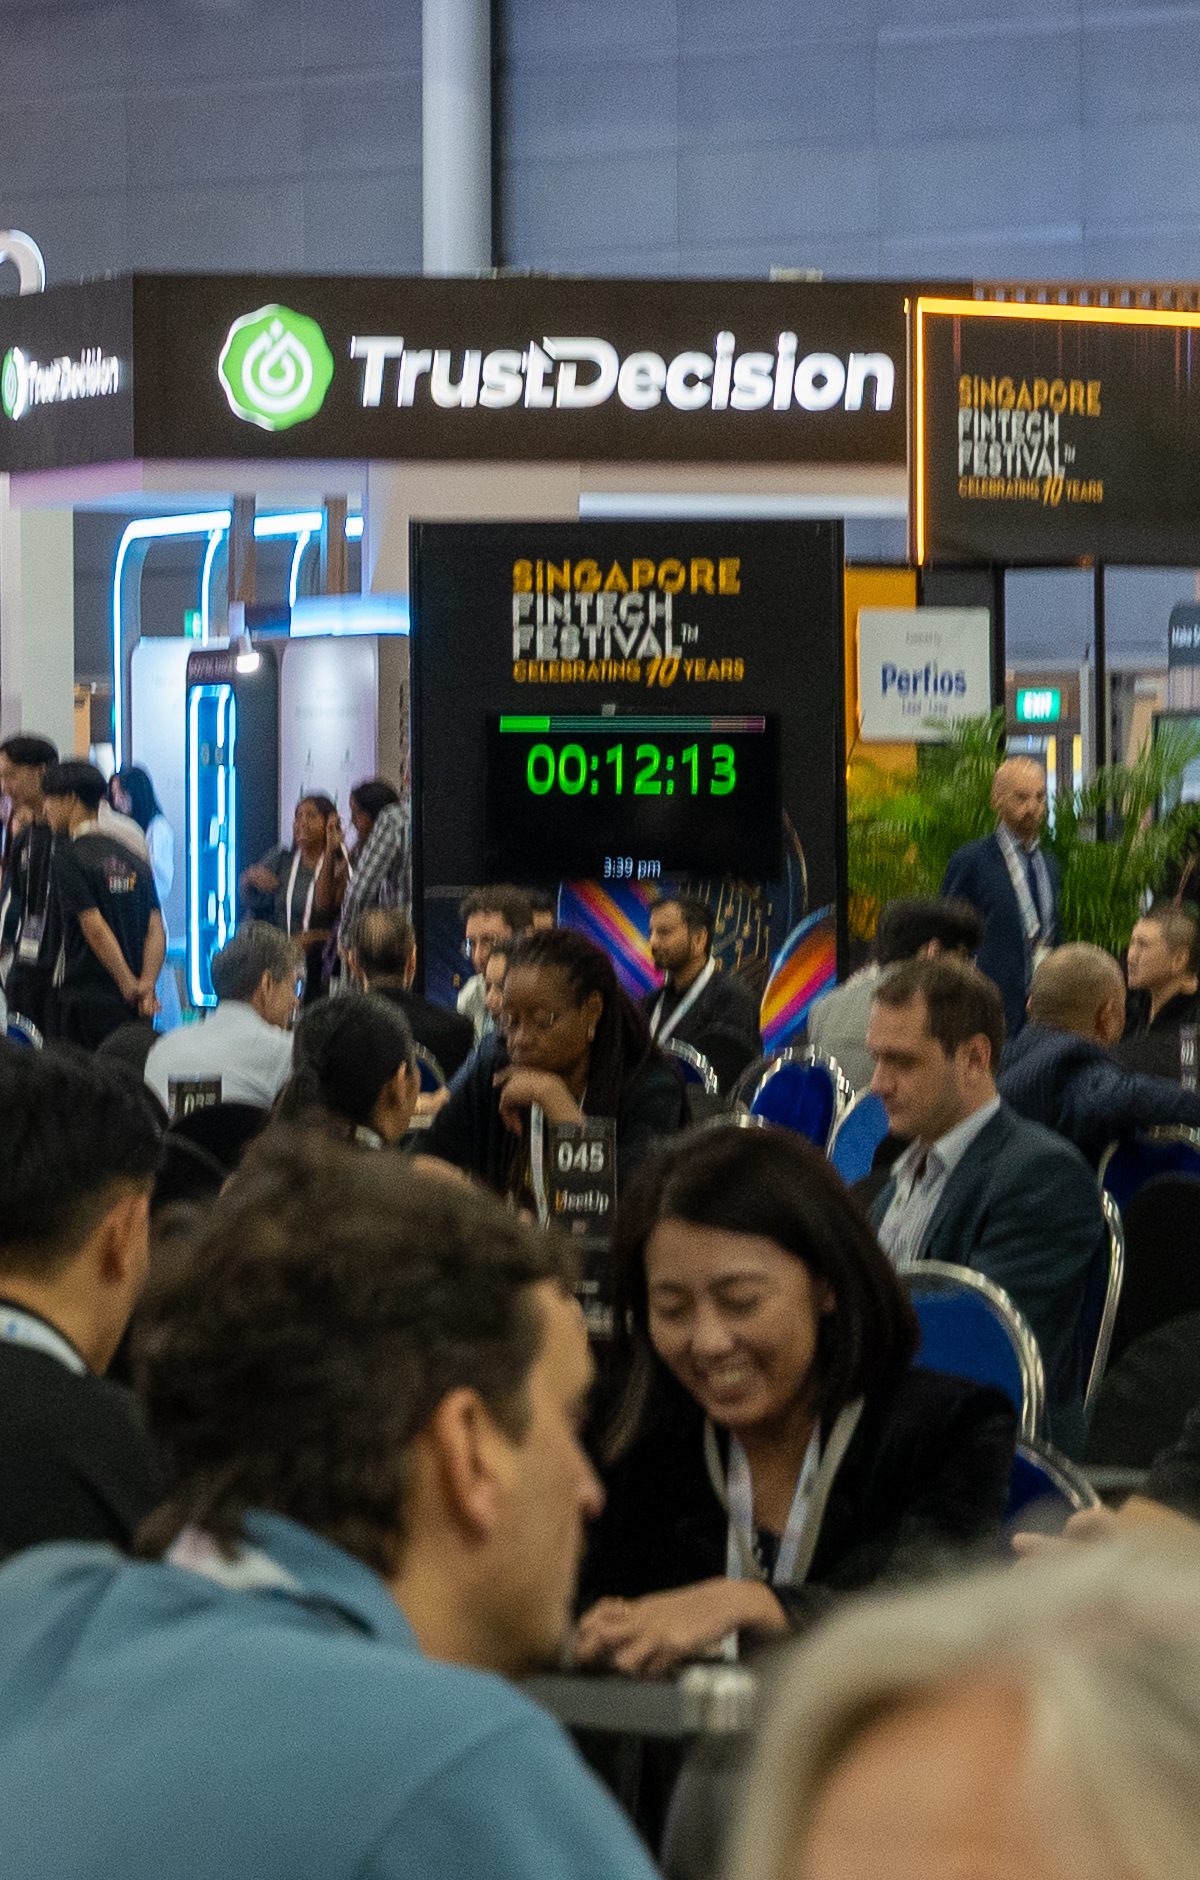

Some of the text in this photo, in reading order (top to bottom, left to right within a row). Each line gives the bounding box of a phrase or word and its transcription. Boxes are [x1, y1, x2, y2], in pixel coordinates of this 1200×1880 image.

[350, 331, 894, 411] TrustDecision
[958, 374, 1102, 417] SINGAPORE
[958, 407, 1060, 446] FINTECH
[958, 439, 1066, 478] FESTIVAL
[512, 558, 742, 595] SINGAPORE
[512, 591, 673, 627] FINTECH
[512, 623, 683, 661] FESTIVAL
[512, 656, 745, 688] CELEBRATING 10 YEARS
[881, 660, 967, 697] Perfios
[527, 743, 737, 796] 00:12:13
[637, 858, 662, 880] pm
